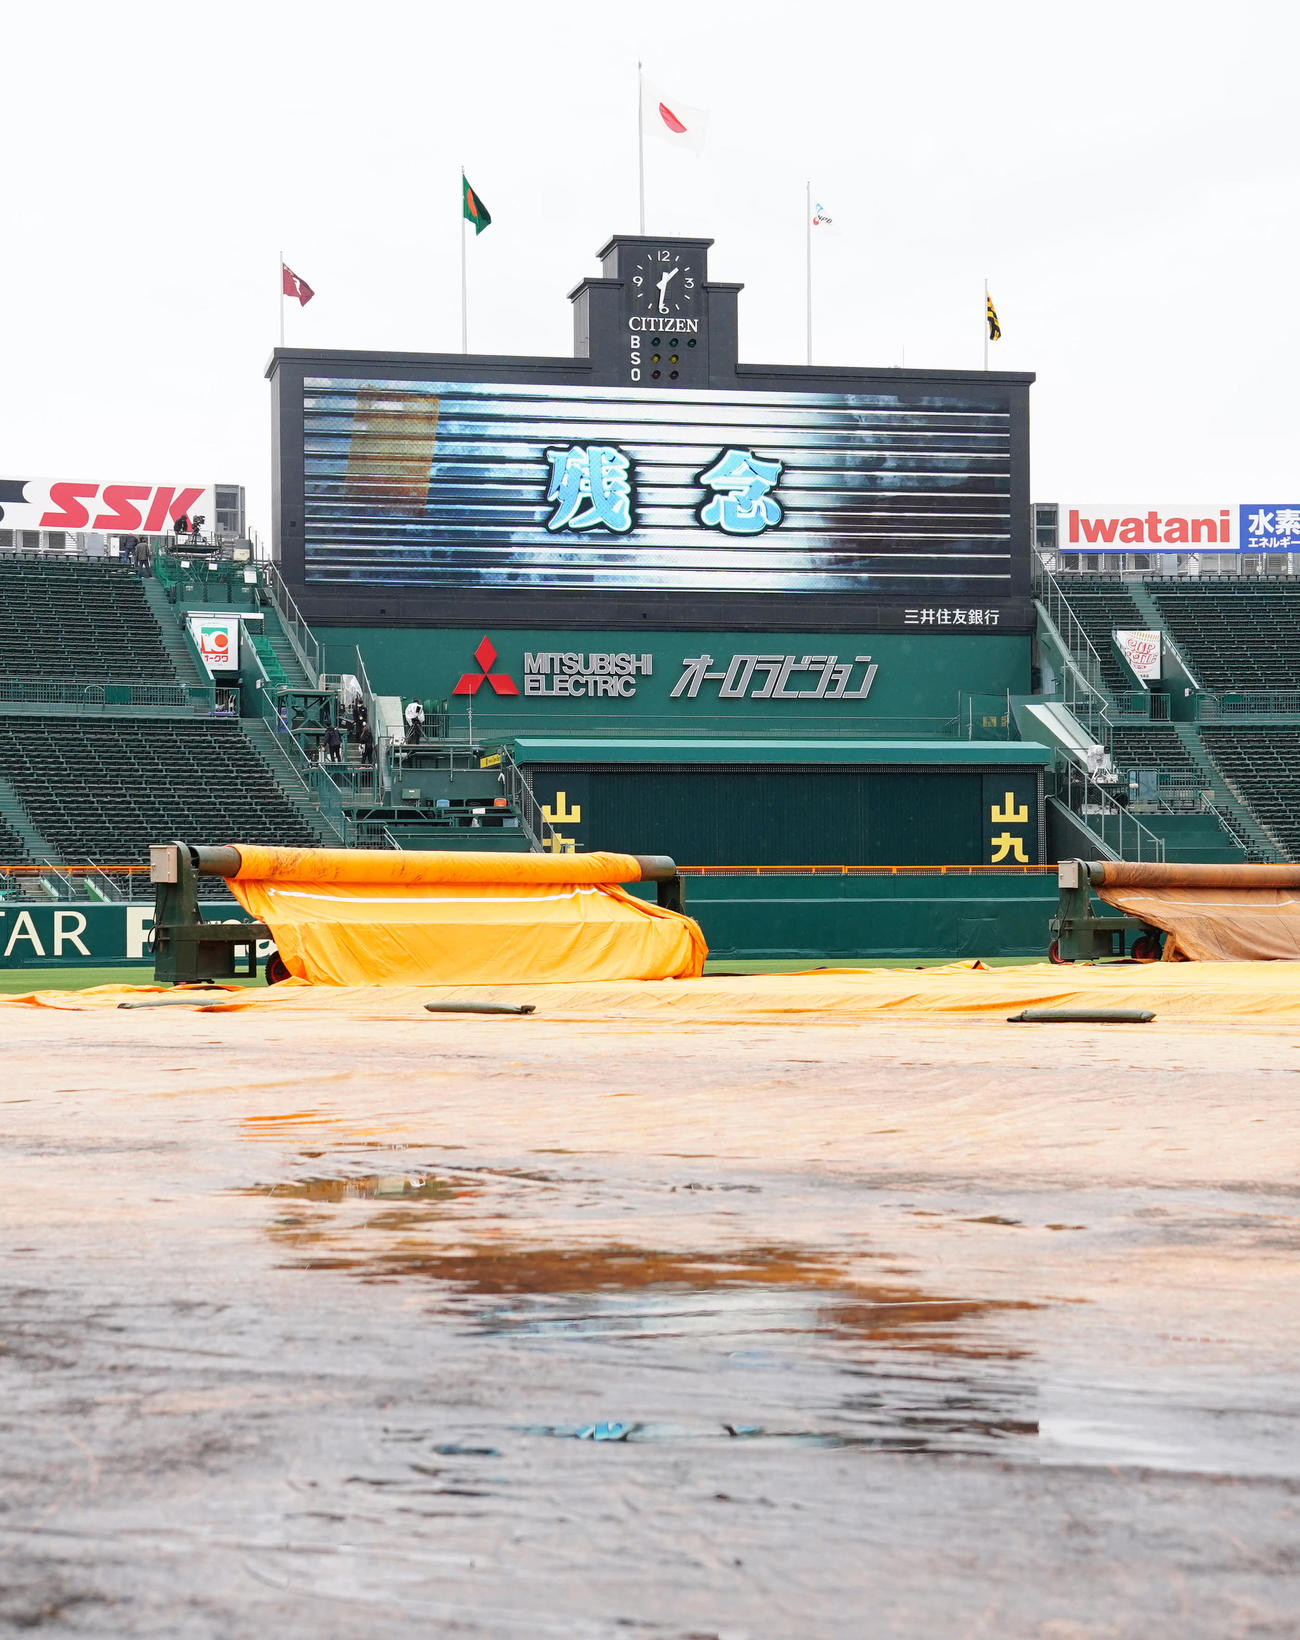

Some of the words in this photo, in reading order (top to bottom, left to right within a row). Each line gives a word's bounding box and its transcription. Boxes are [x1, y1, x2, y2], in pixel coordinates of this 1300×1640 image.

[657, 250, 671, 262] 12
[632, 276, 643, 287] 9
[684, 277, 695, 289] 3
[659, 303, 670, 315] 6
[628, 316, 699, 333] CITIZEN
[630, 335, 641, 349] B
[630, 352, 641, 365] S
[545, 443, 784, 535] 残念
[39, 482, 206, 532] SSK
[1068, 509, 1230, 543] Iwatani
[1248, 508, 1300, 536] 水素
[1248, 536, 1300, 549] エネルギー
[903, 608, 1000, 625] 三井住友銀行
[524, 652, 653, 675] MITSUBISHI
[524, 675, 636, 697] ELECTRIC
[669, 654, 879, 699] オーロラビジョン
[991, 791, 1029, 863] 山九
[0, 910, 92, 957] AR
